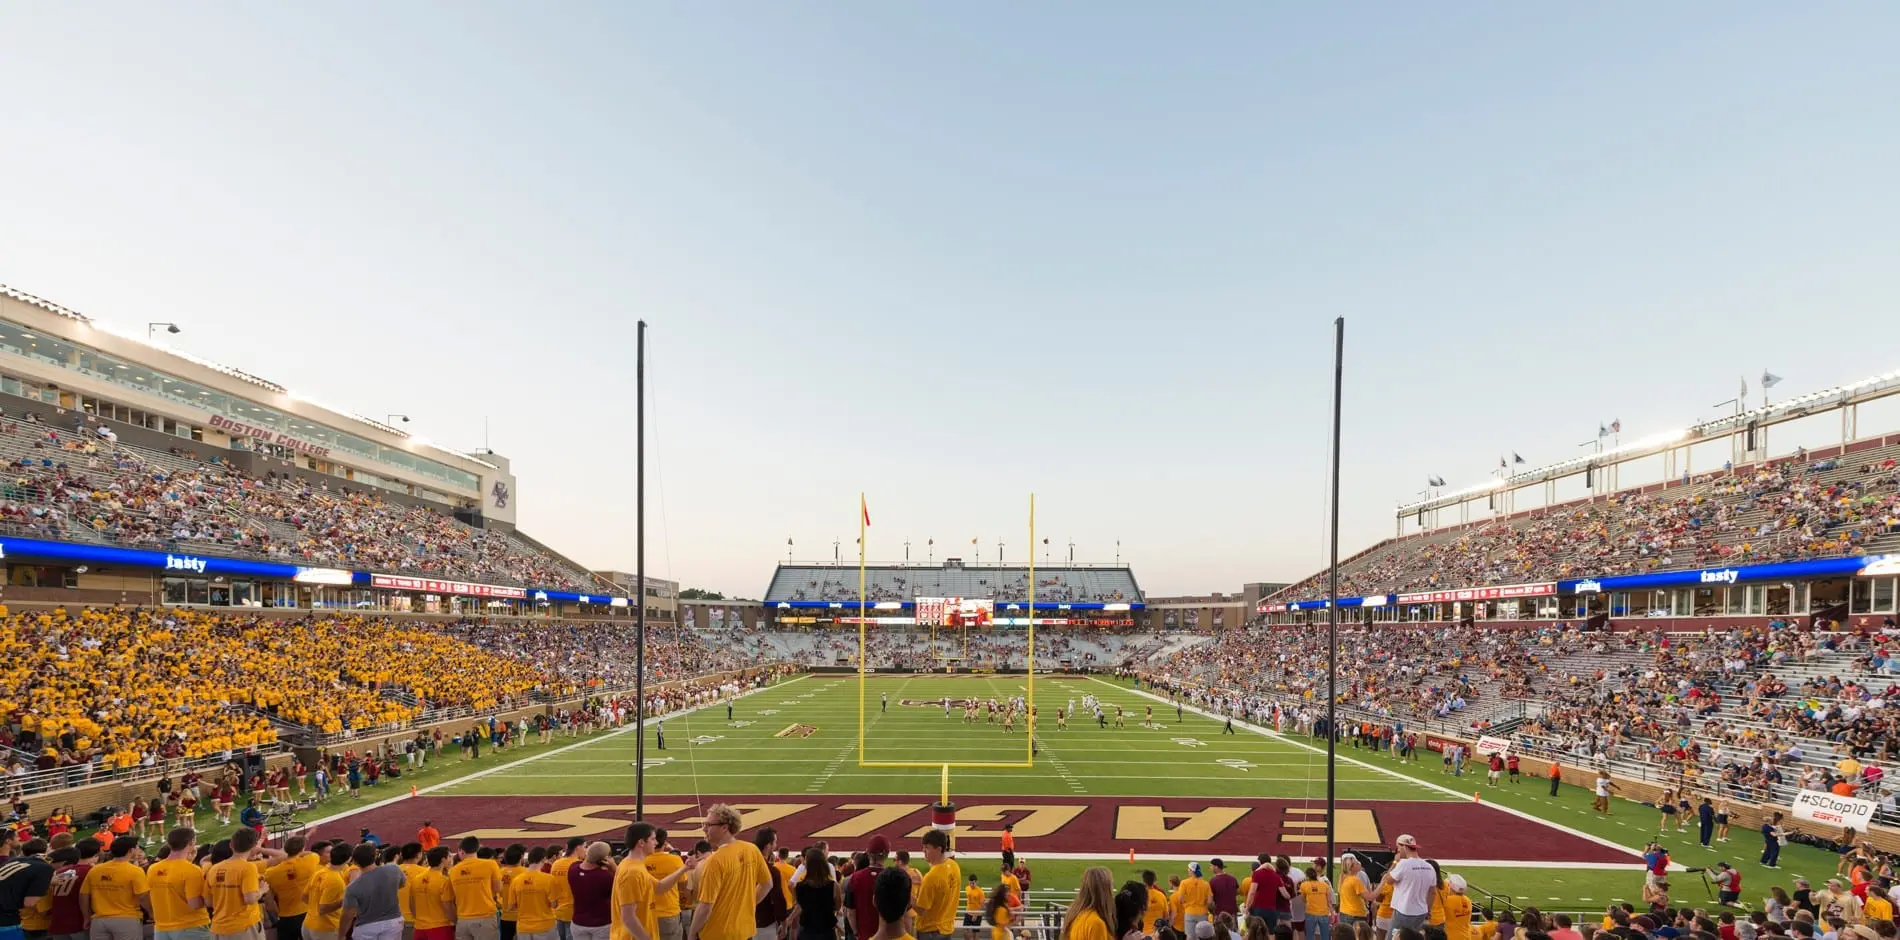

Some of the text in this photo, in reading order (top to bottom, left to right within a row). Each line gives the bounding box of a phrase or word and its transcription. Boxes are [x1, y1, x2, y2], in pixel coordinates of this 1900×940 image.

[209, 414, 330, 457] BOSTON COLLEGE
[166, 554, 207, 573] tasty
[1700, 569, 1738, 584] tasty
[1800, 793, 1869, 817] #SCtop10
[441, 803, 1384, 844] EAGLES
[1812, 810, 1843, 824] ESPN
